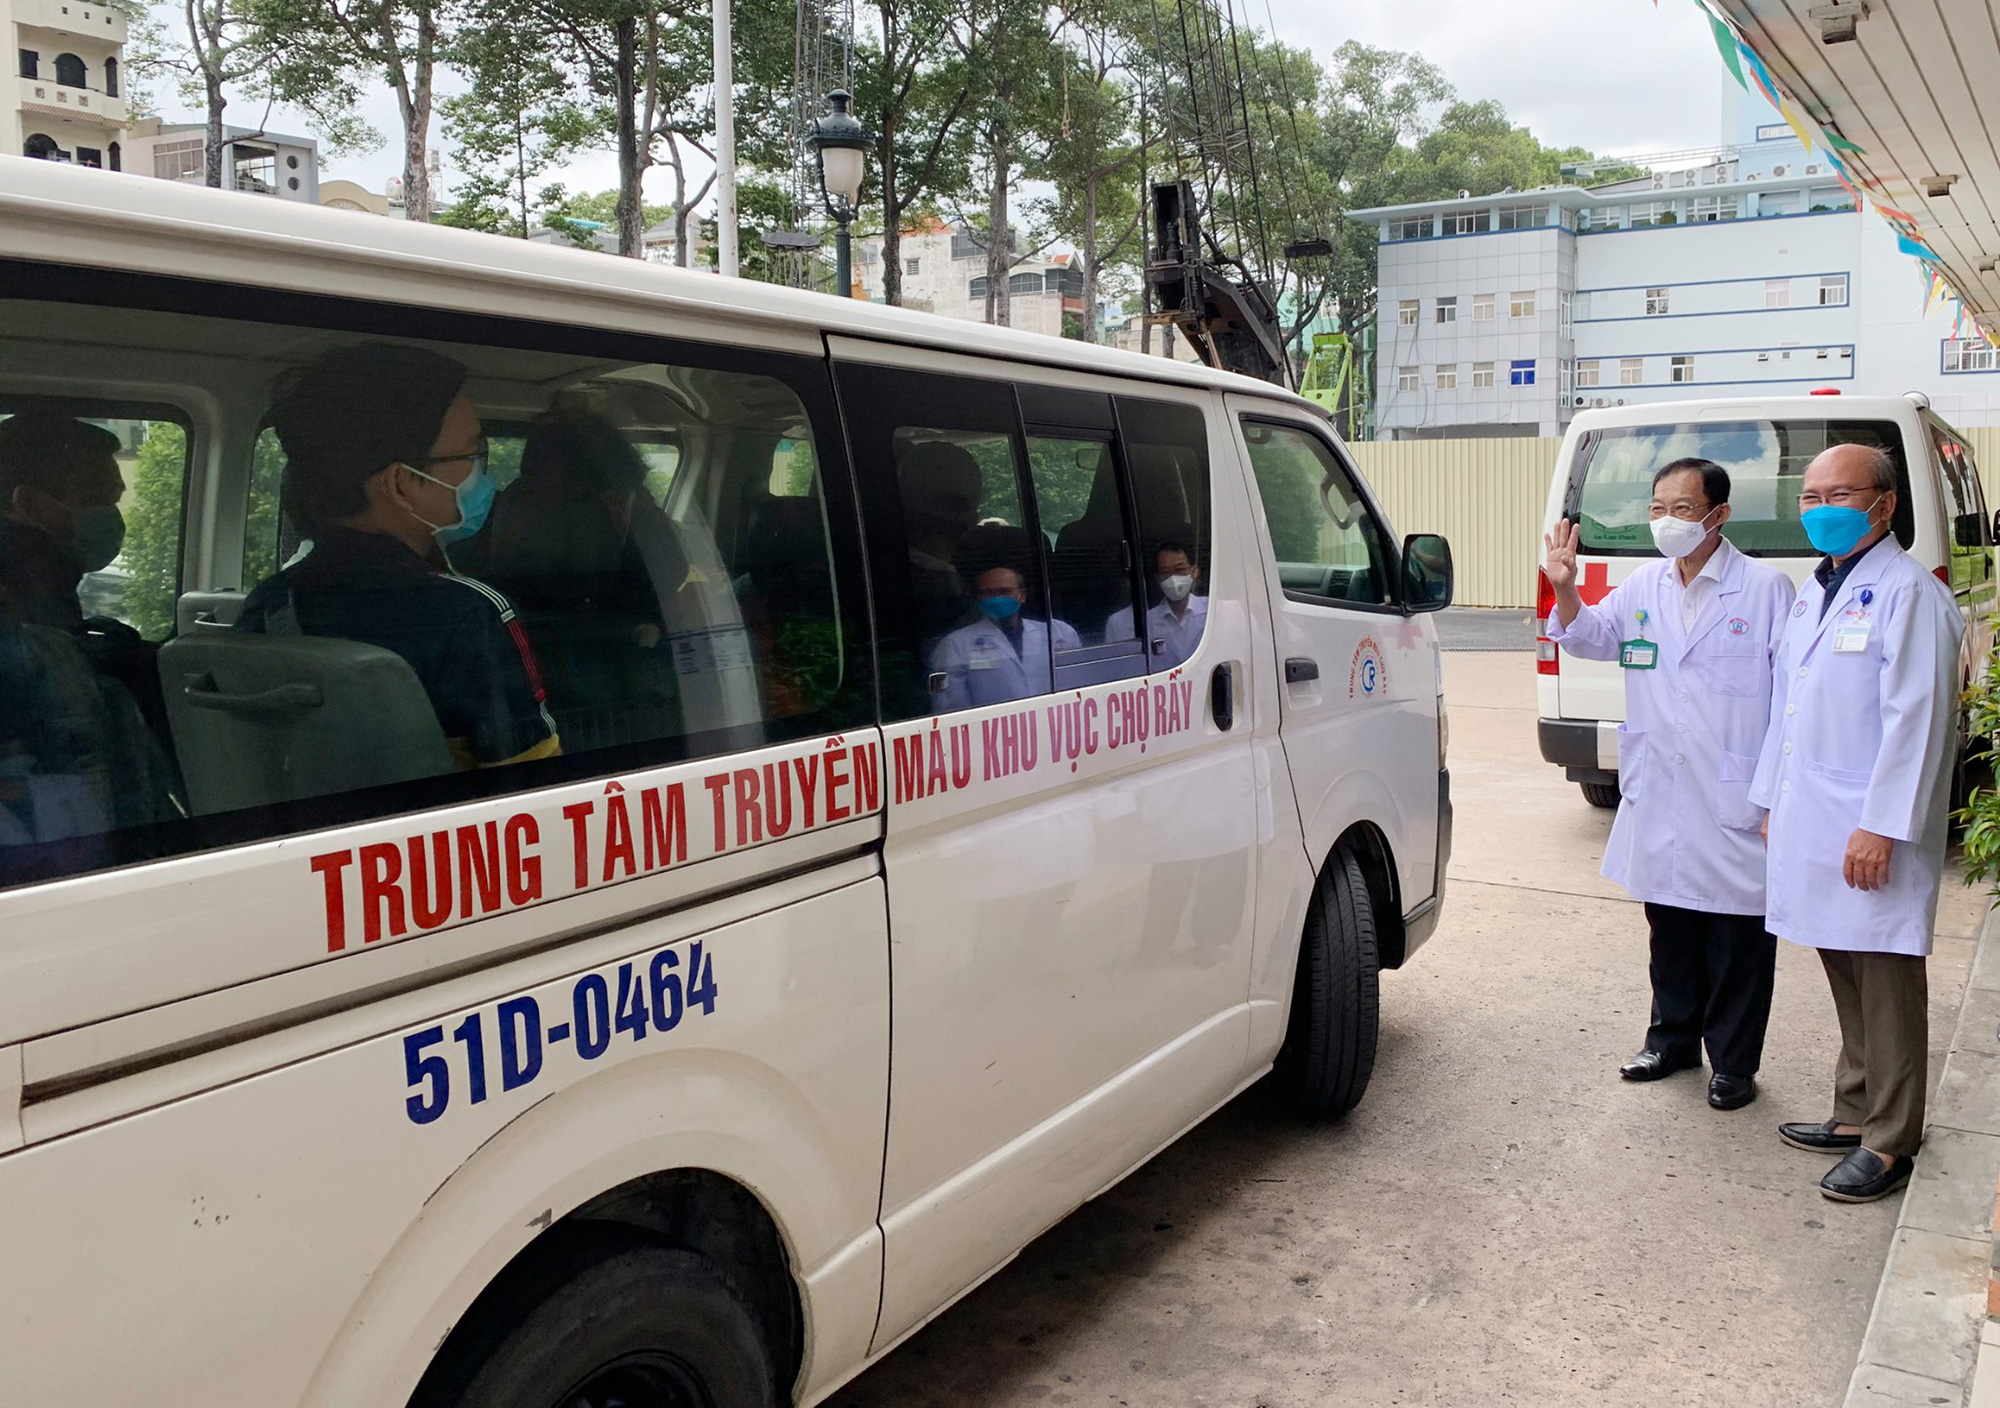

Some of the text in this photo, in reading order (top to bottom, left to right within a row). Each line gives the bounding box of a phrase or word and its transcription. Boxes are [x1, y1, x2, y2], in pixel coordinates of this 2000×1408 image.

[310, 668, 1193, 953] TRUNG TÂM TRUYỀN MÁU KHU VỰC CHỢ RẪY
[404, 938, 719, 1125] 51D-0464
